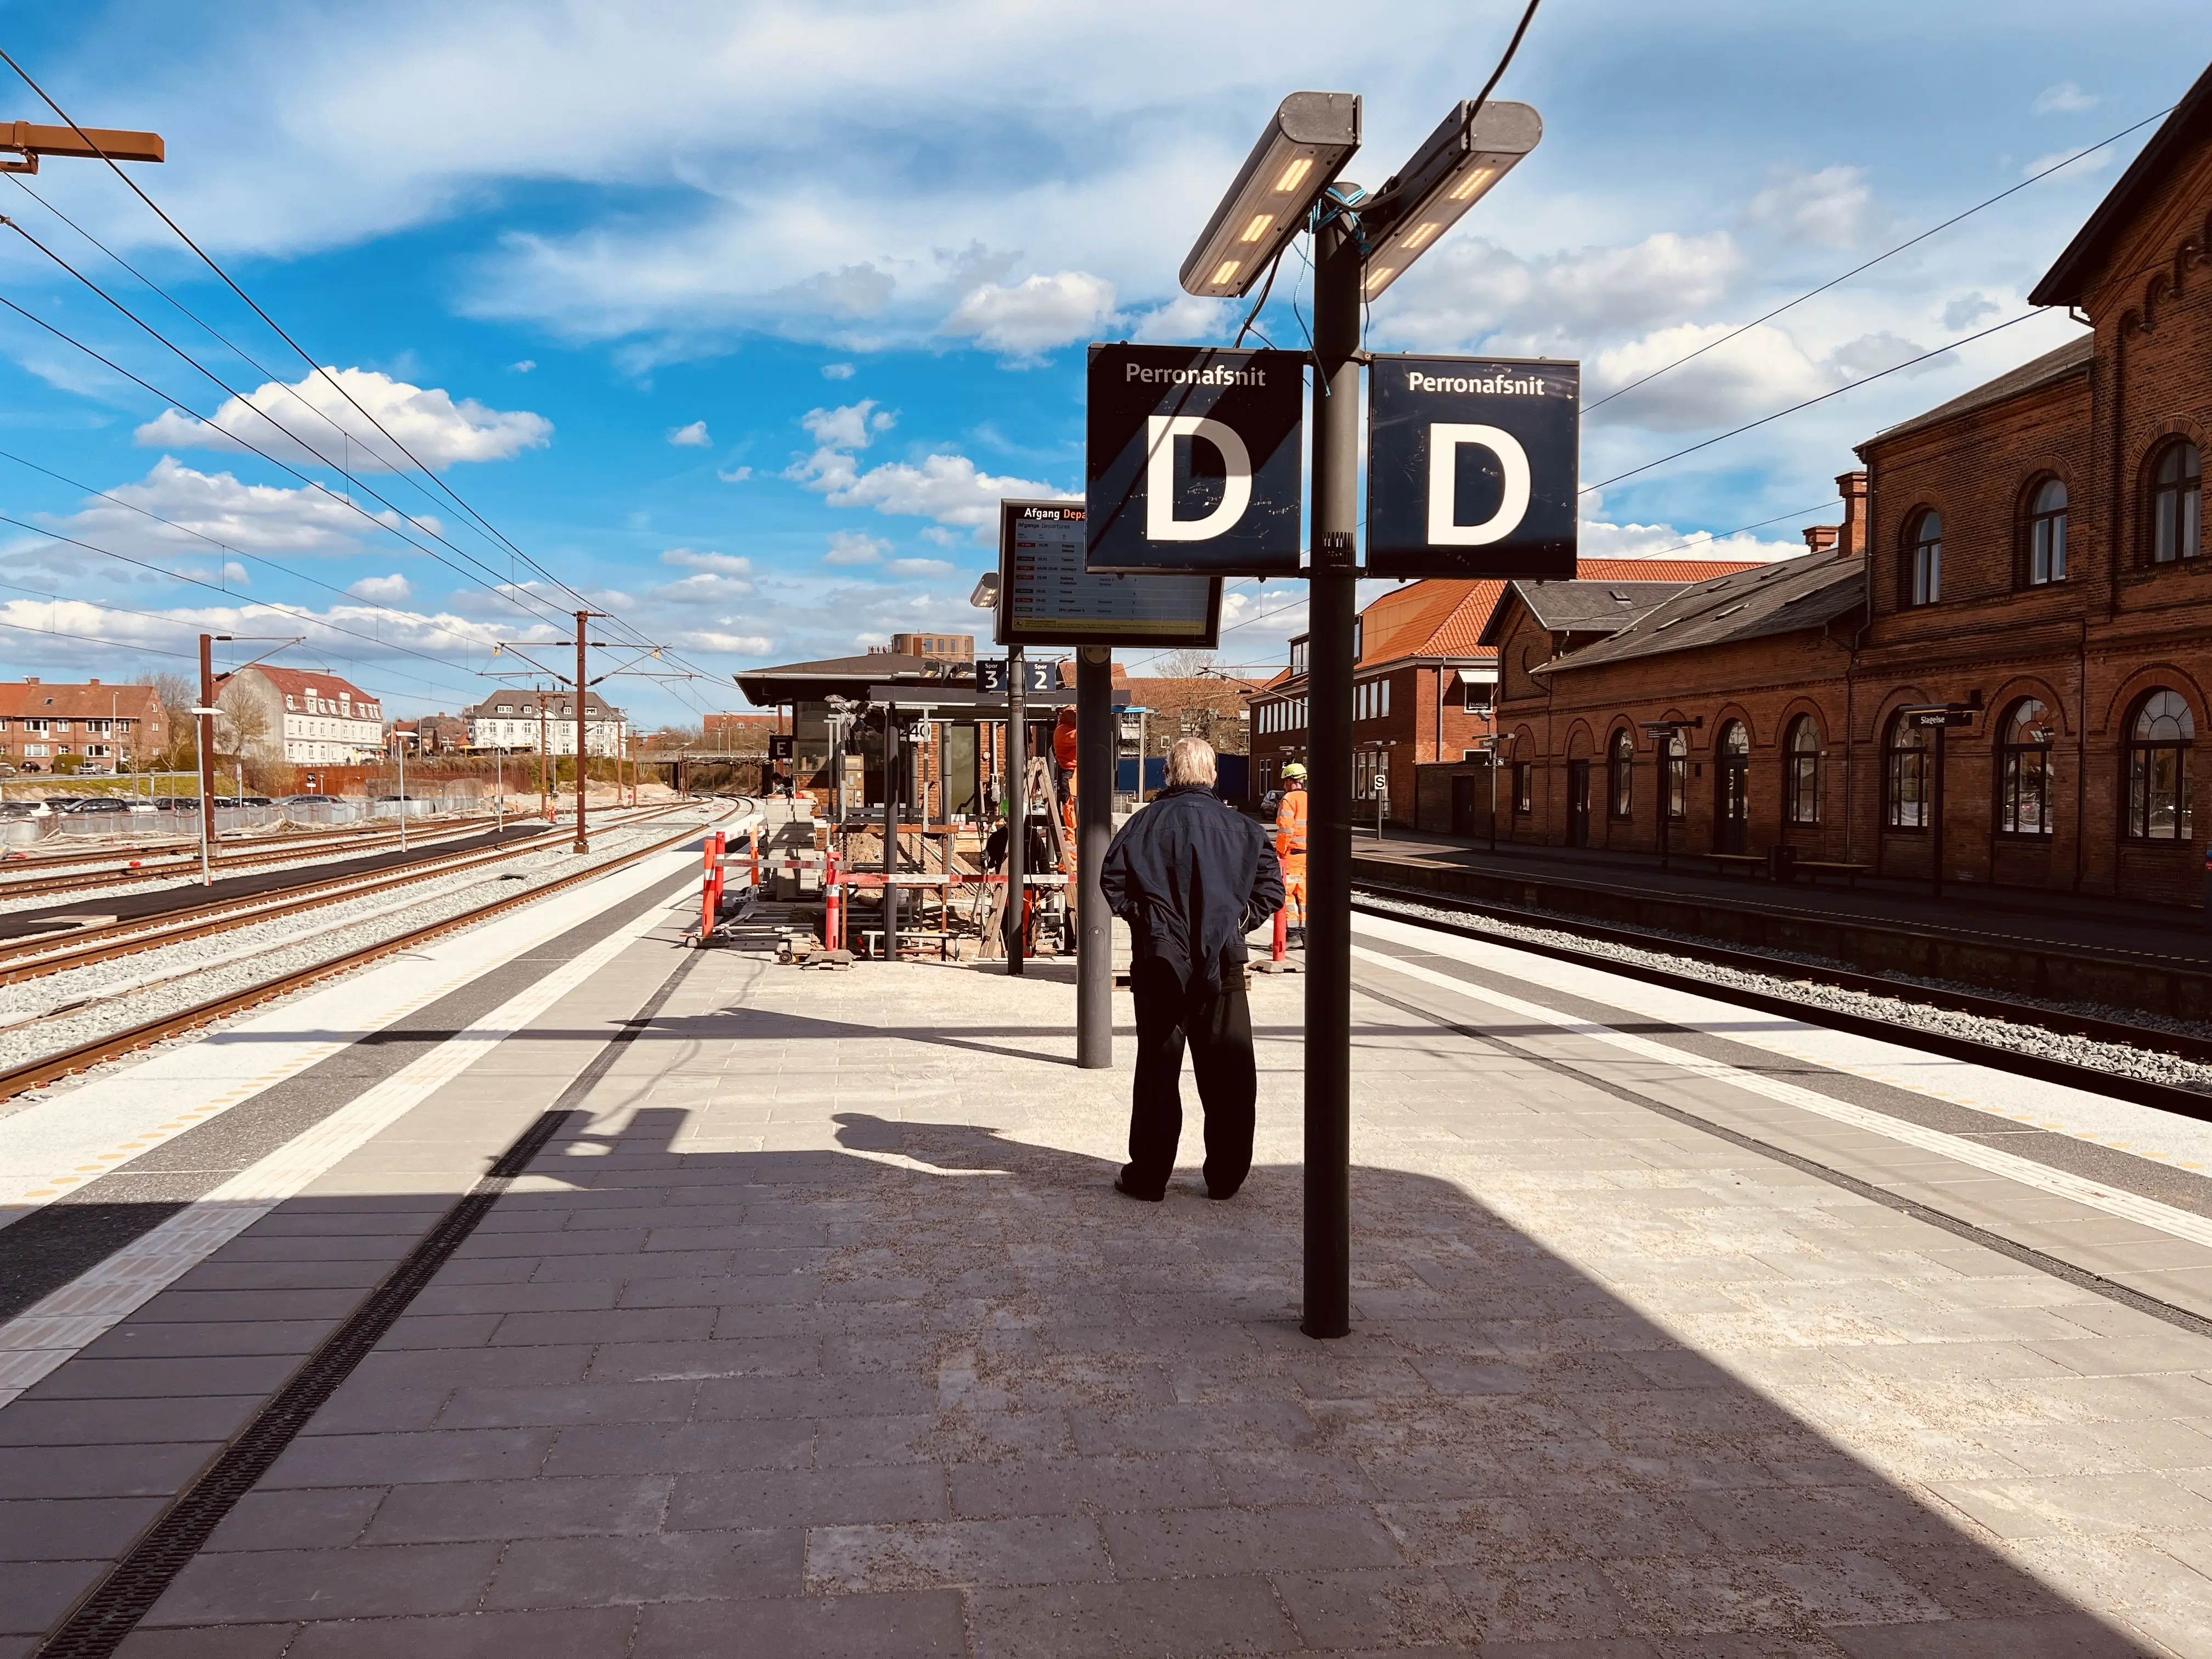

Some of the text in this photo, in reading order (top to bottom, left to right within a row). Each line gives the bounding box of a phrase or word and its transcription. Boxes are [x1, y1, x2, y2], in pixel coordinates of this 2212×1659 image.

[1126, 363, 1266, 386] Perronafsnit
[1409, 371, 1545, 395] Perronafsnit
[1147, 415, 1252, 541] D
[1427, 423, 1531, 545] D
[1024, 507, 1060, 521] Afgang
[985, 670, 998, 689] 3
[1034, 671, 1047, 689] 2
[1921, 716, 1945, 724] Slagelse
[777, 742, 786, 755] E
[1375, 776, 1384, 788] S
